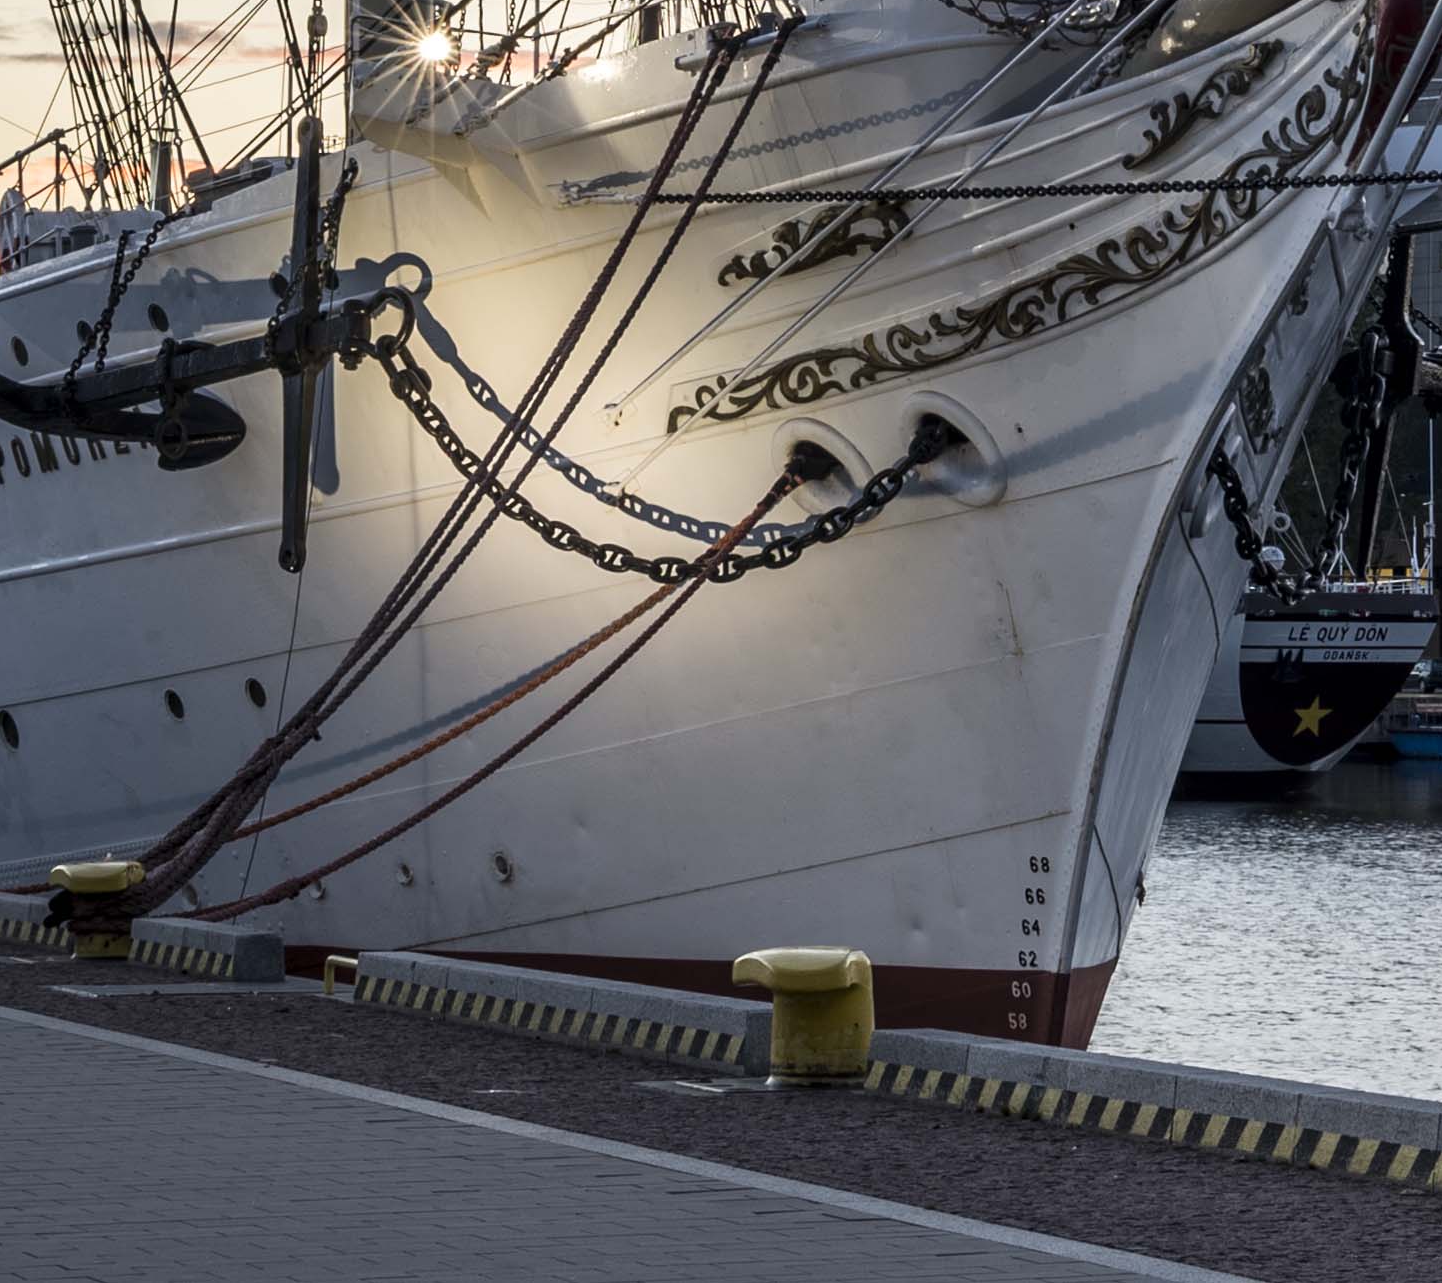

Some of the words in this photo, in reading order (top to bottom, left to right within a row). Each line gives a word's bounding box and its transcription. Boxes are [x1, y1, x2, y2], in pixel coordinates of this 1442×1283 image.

[1029, 856, 1050, 873] 68
[1024, 887, 1045, 905] 66
[1021, 918, 1040, 936] 64
[1018, 950, 1038, 967] 62
[1011, 981, 1032, 998] 60
[1008, 1012, 1027, 1030] 58
